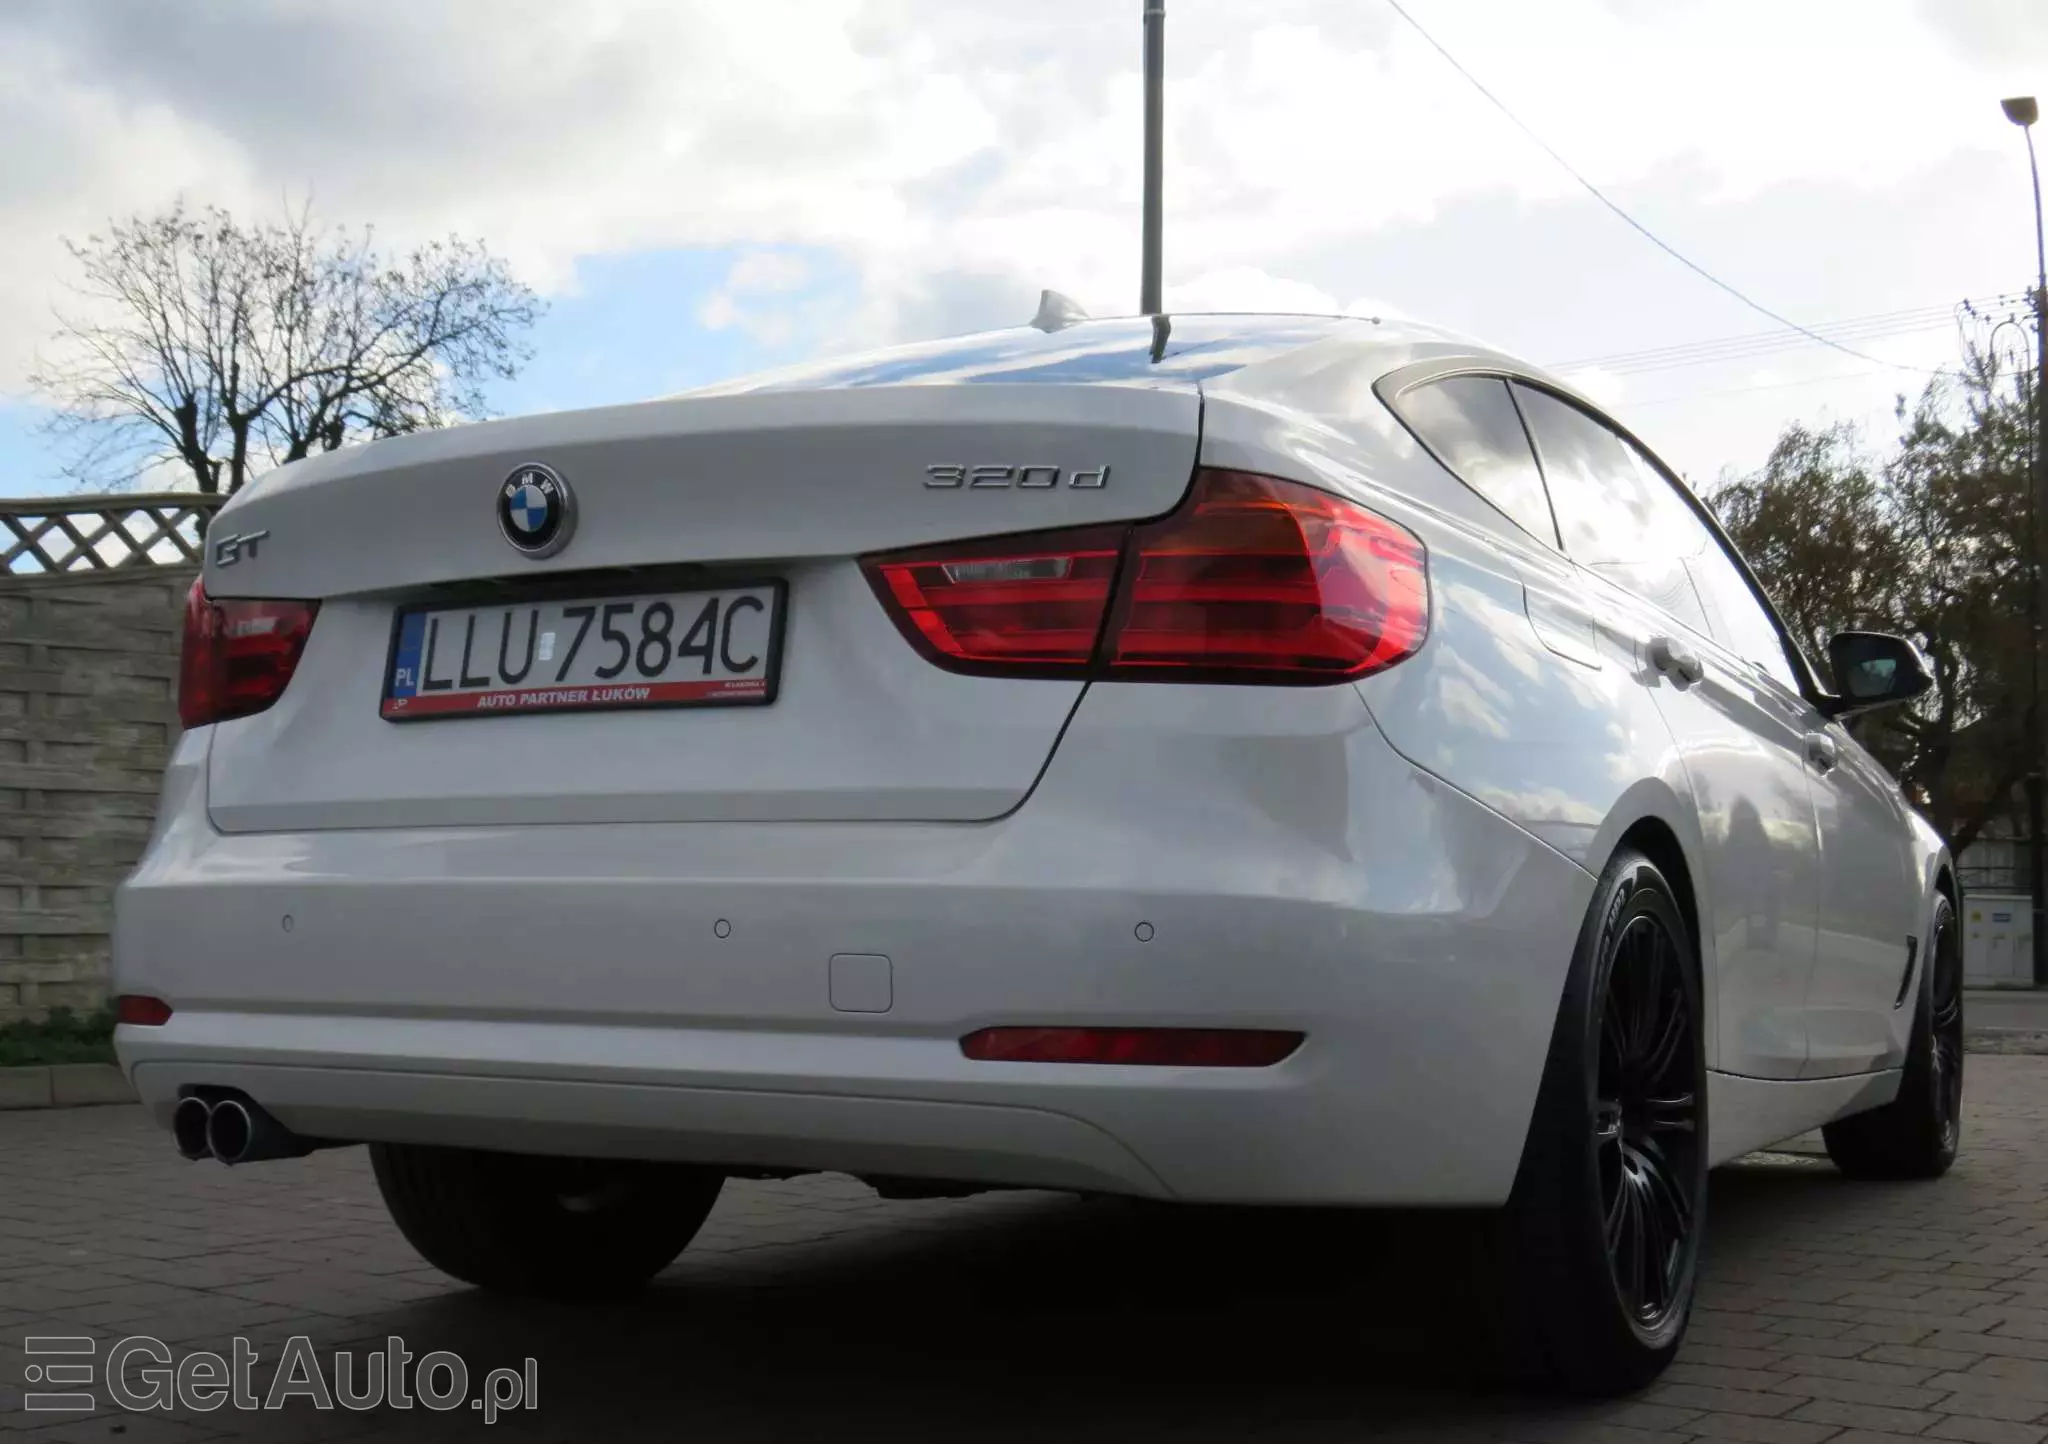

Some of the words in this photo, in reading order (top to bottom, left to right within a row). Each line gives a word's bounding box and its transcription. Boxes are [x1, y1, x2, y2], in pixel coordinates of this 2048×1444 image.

[505, 472, 554, 498] BMW
[216, 530, 270, 568] GT
[422, 610, 539, 691] LLU
[555, 596, 765, 683] 7584C
[395, 667, 414, 687] PL
[476, 694, 516, 708] AUTO
[519, 690, 588, 705] PARTNER
